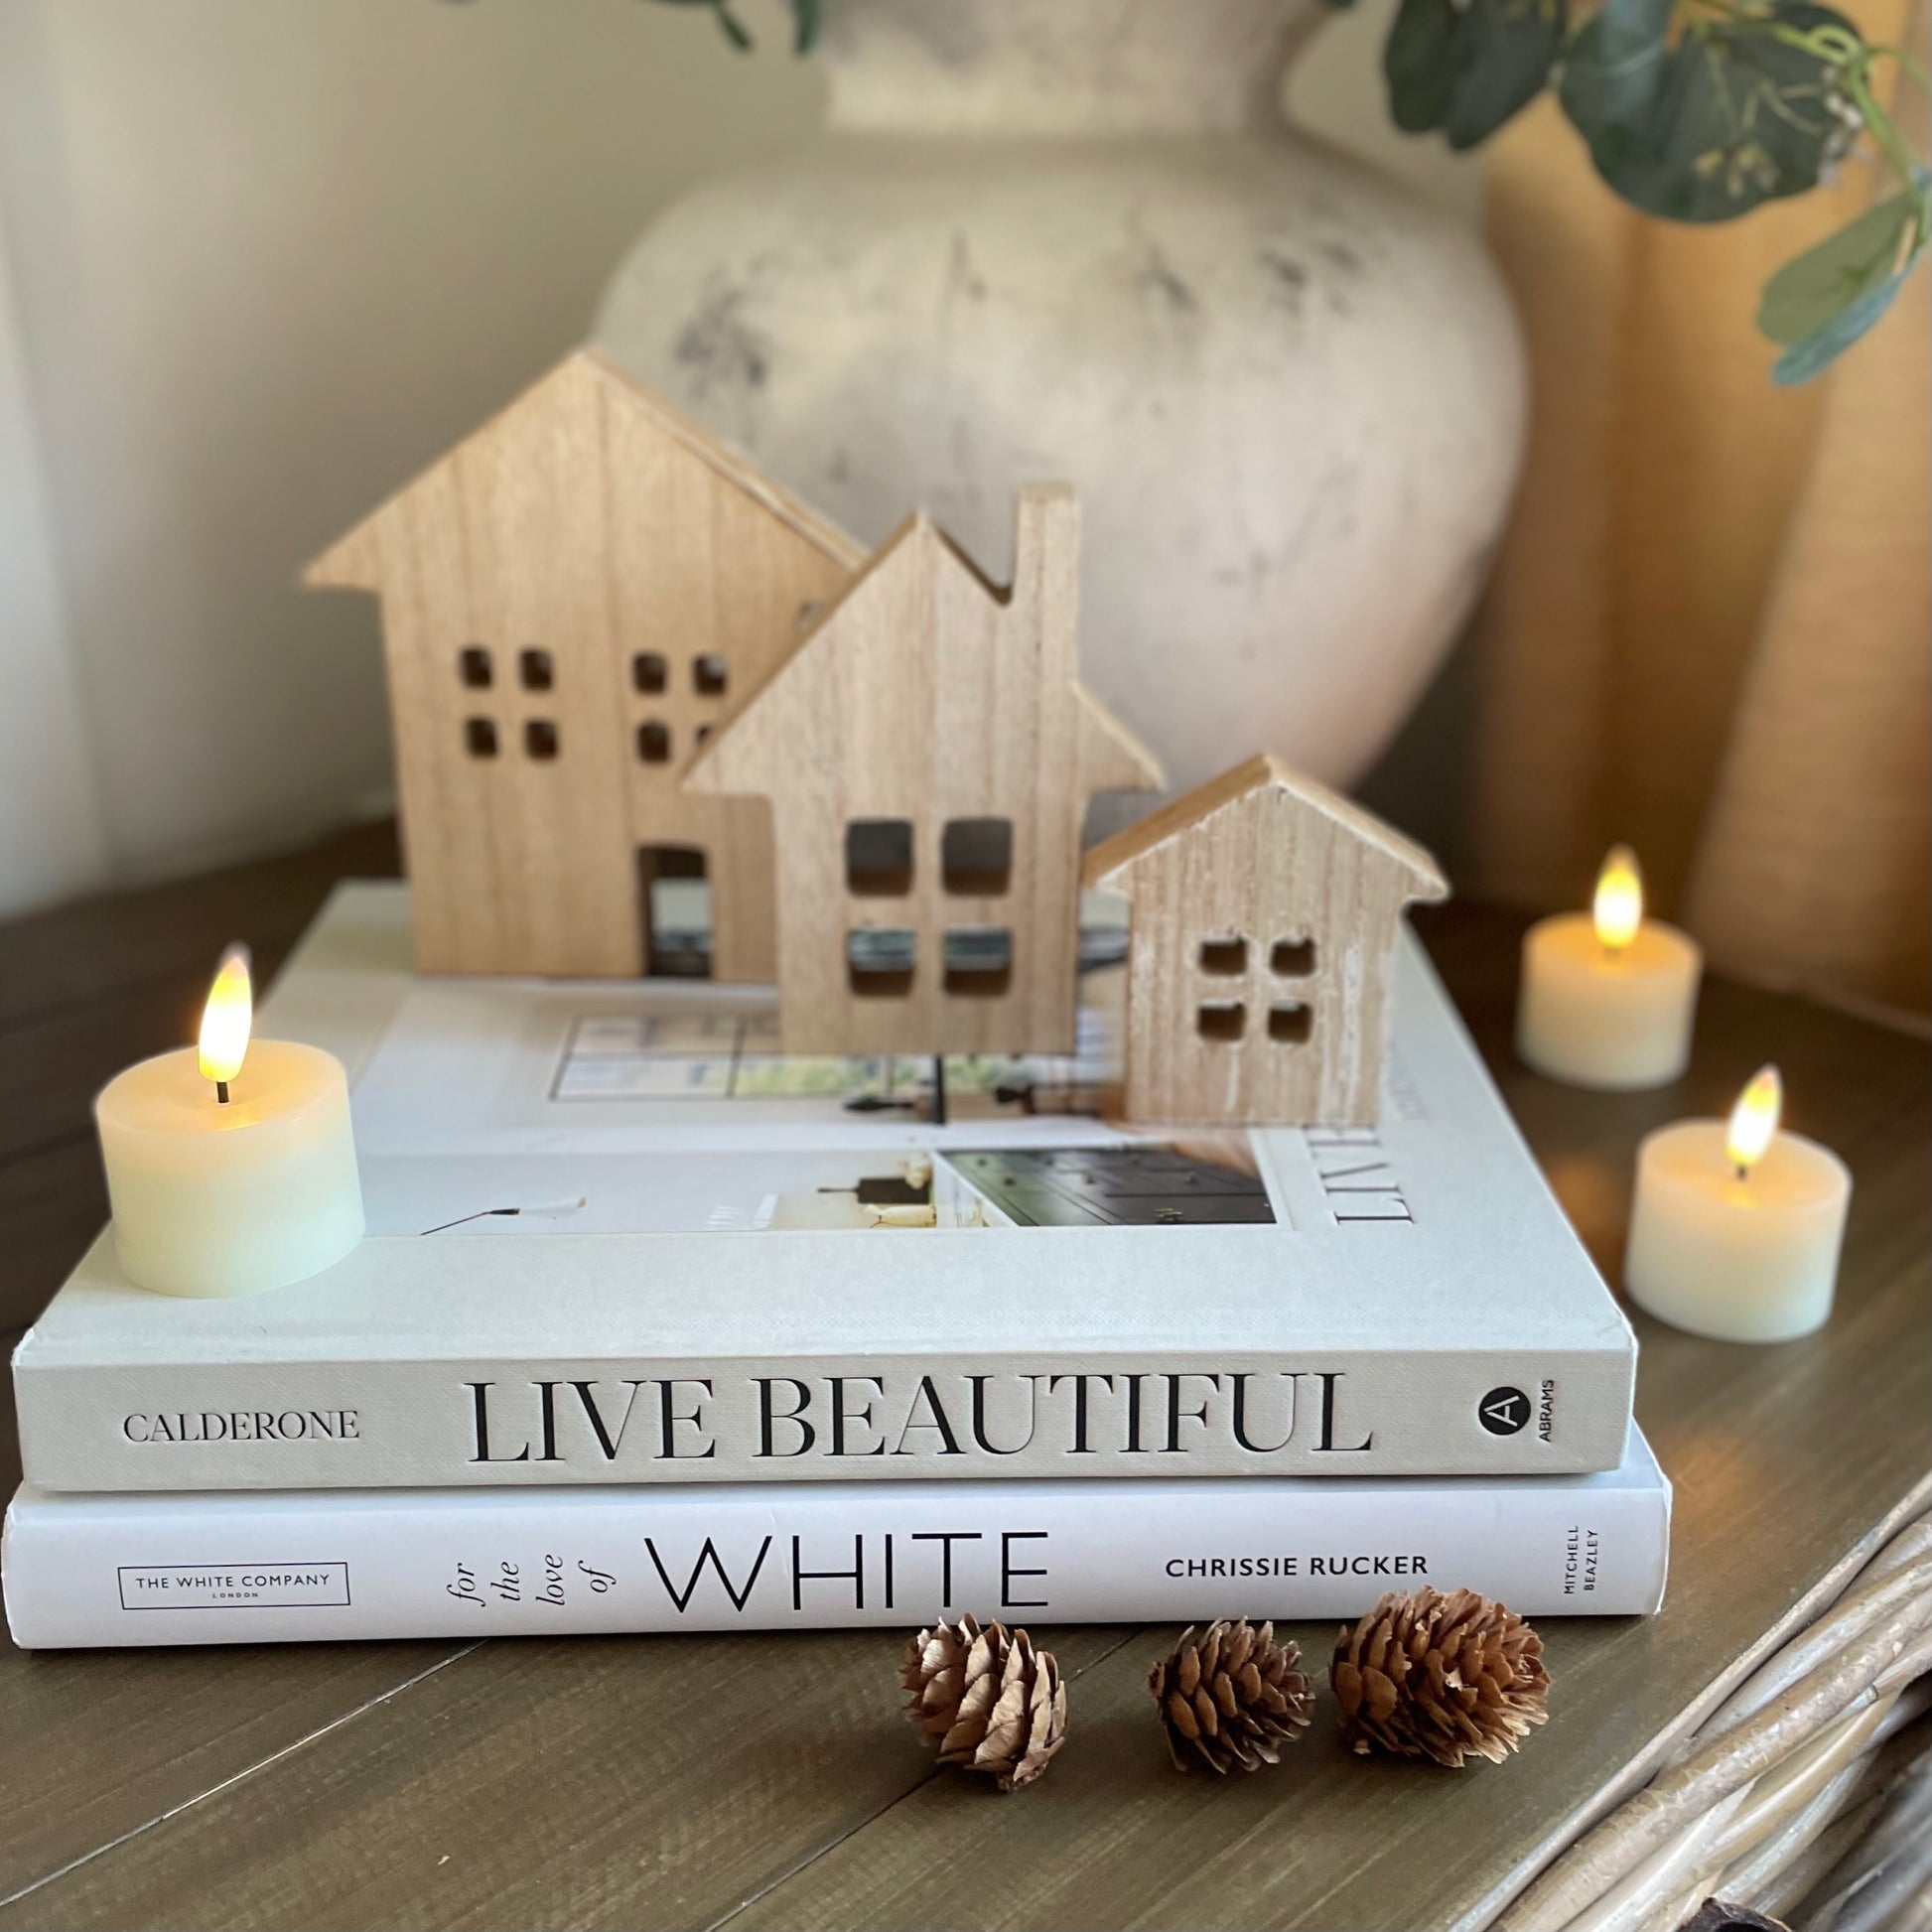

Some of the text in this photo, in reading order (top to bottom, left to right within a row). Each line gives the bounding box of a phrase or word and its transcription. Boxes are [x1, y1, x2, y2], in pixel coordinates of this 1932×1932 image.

[123, 1410, 360, 1443] CALDERONE
[463, 1372, 1375, 1462] LIVE BEAUTIFUL
[1539, 1379, 1555, 1443] ABRAMS
[135, 1574, 330, 1588] THE WHITE COMPANY
[489, 1561, 521, 1601] the
[534, 1554, 566, 1606] love
[578, 1560, 618, 1593] of
[643, 1531, 1049, 1613] WHITE
[1165, 1555, 1429, 1578] CHRISSIE RUCKER
[1564, 1525, 1580, 1594] MITCHELL
[1583, 1530, 1598, 1591] BEAZLEY
[446, 1562, 486, 1607] for
